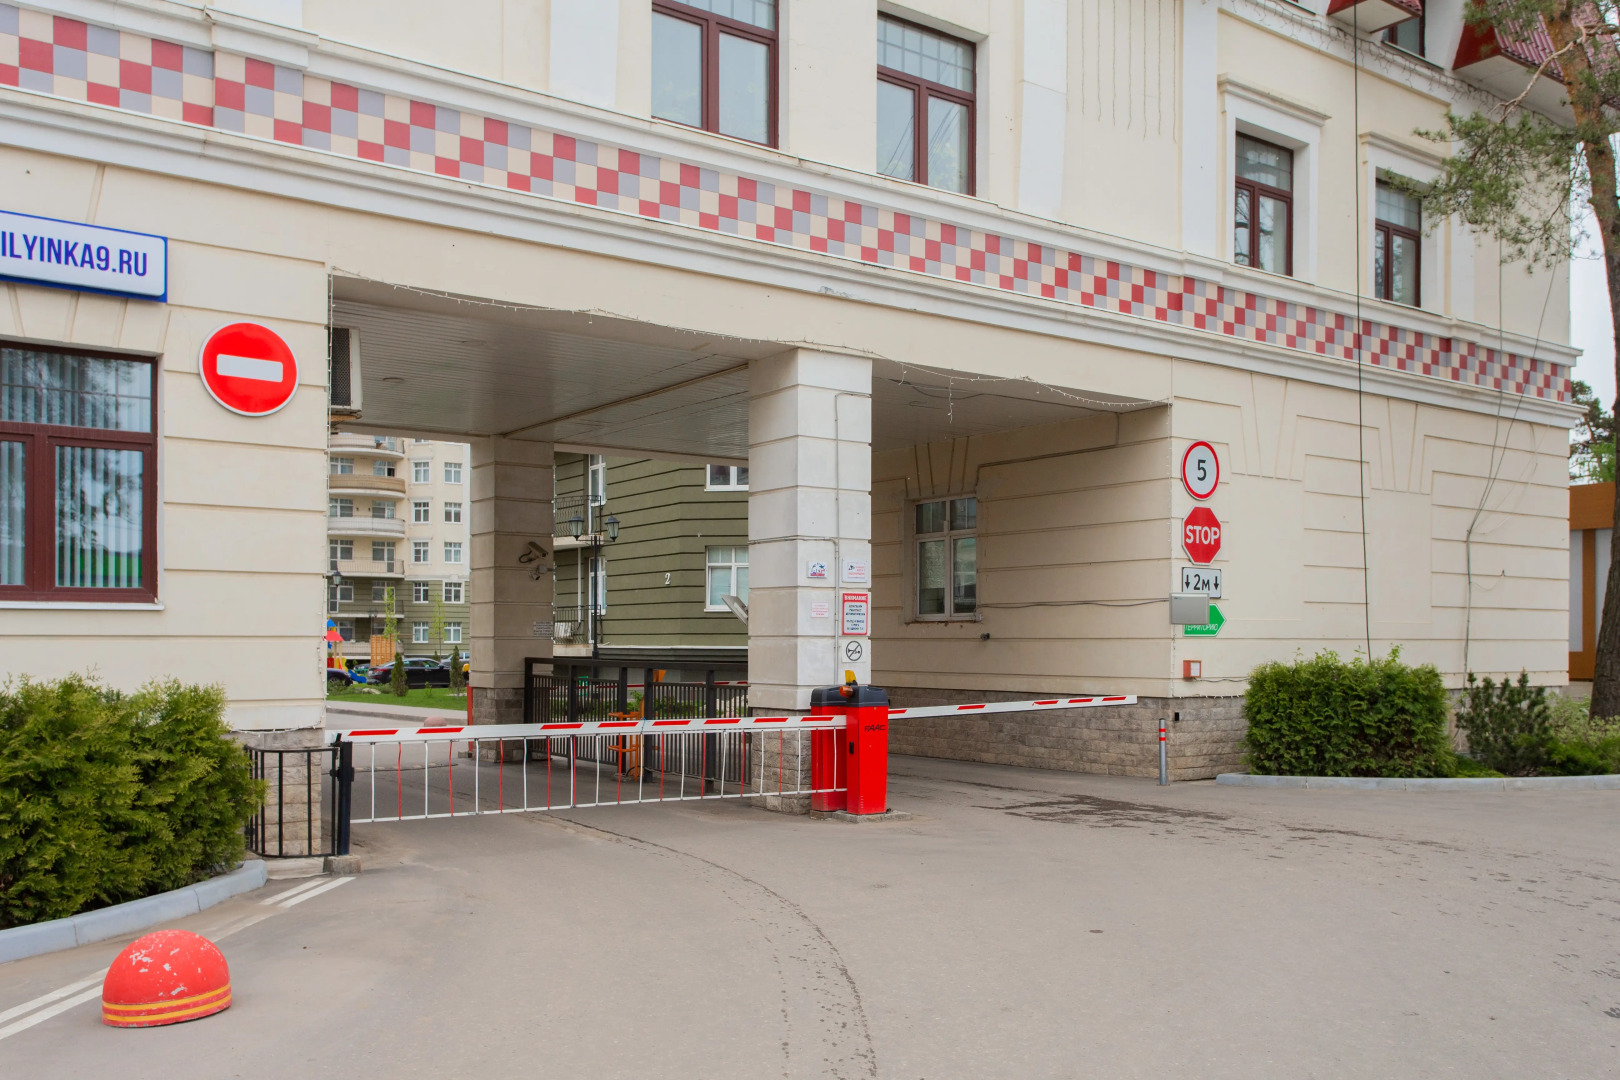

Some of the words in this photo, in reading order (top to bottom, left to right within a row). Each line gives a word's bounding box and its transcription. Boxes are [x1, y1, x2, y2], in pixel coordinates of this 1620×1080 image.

[1, 231, 148, 277] ILYINKA9.RU
[1197, 459, 1207, 481] 5
[1185, 525, 1220, 545] STOP
[664, 572, 671, 585] 2
